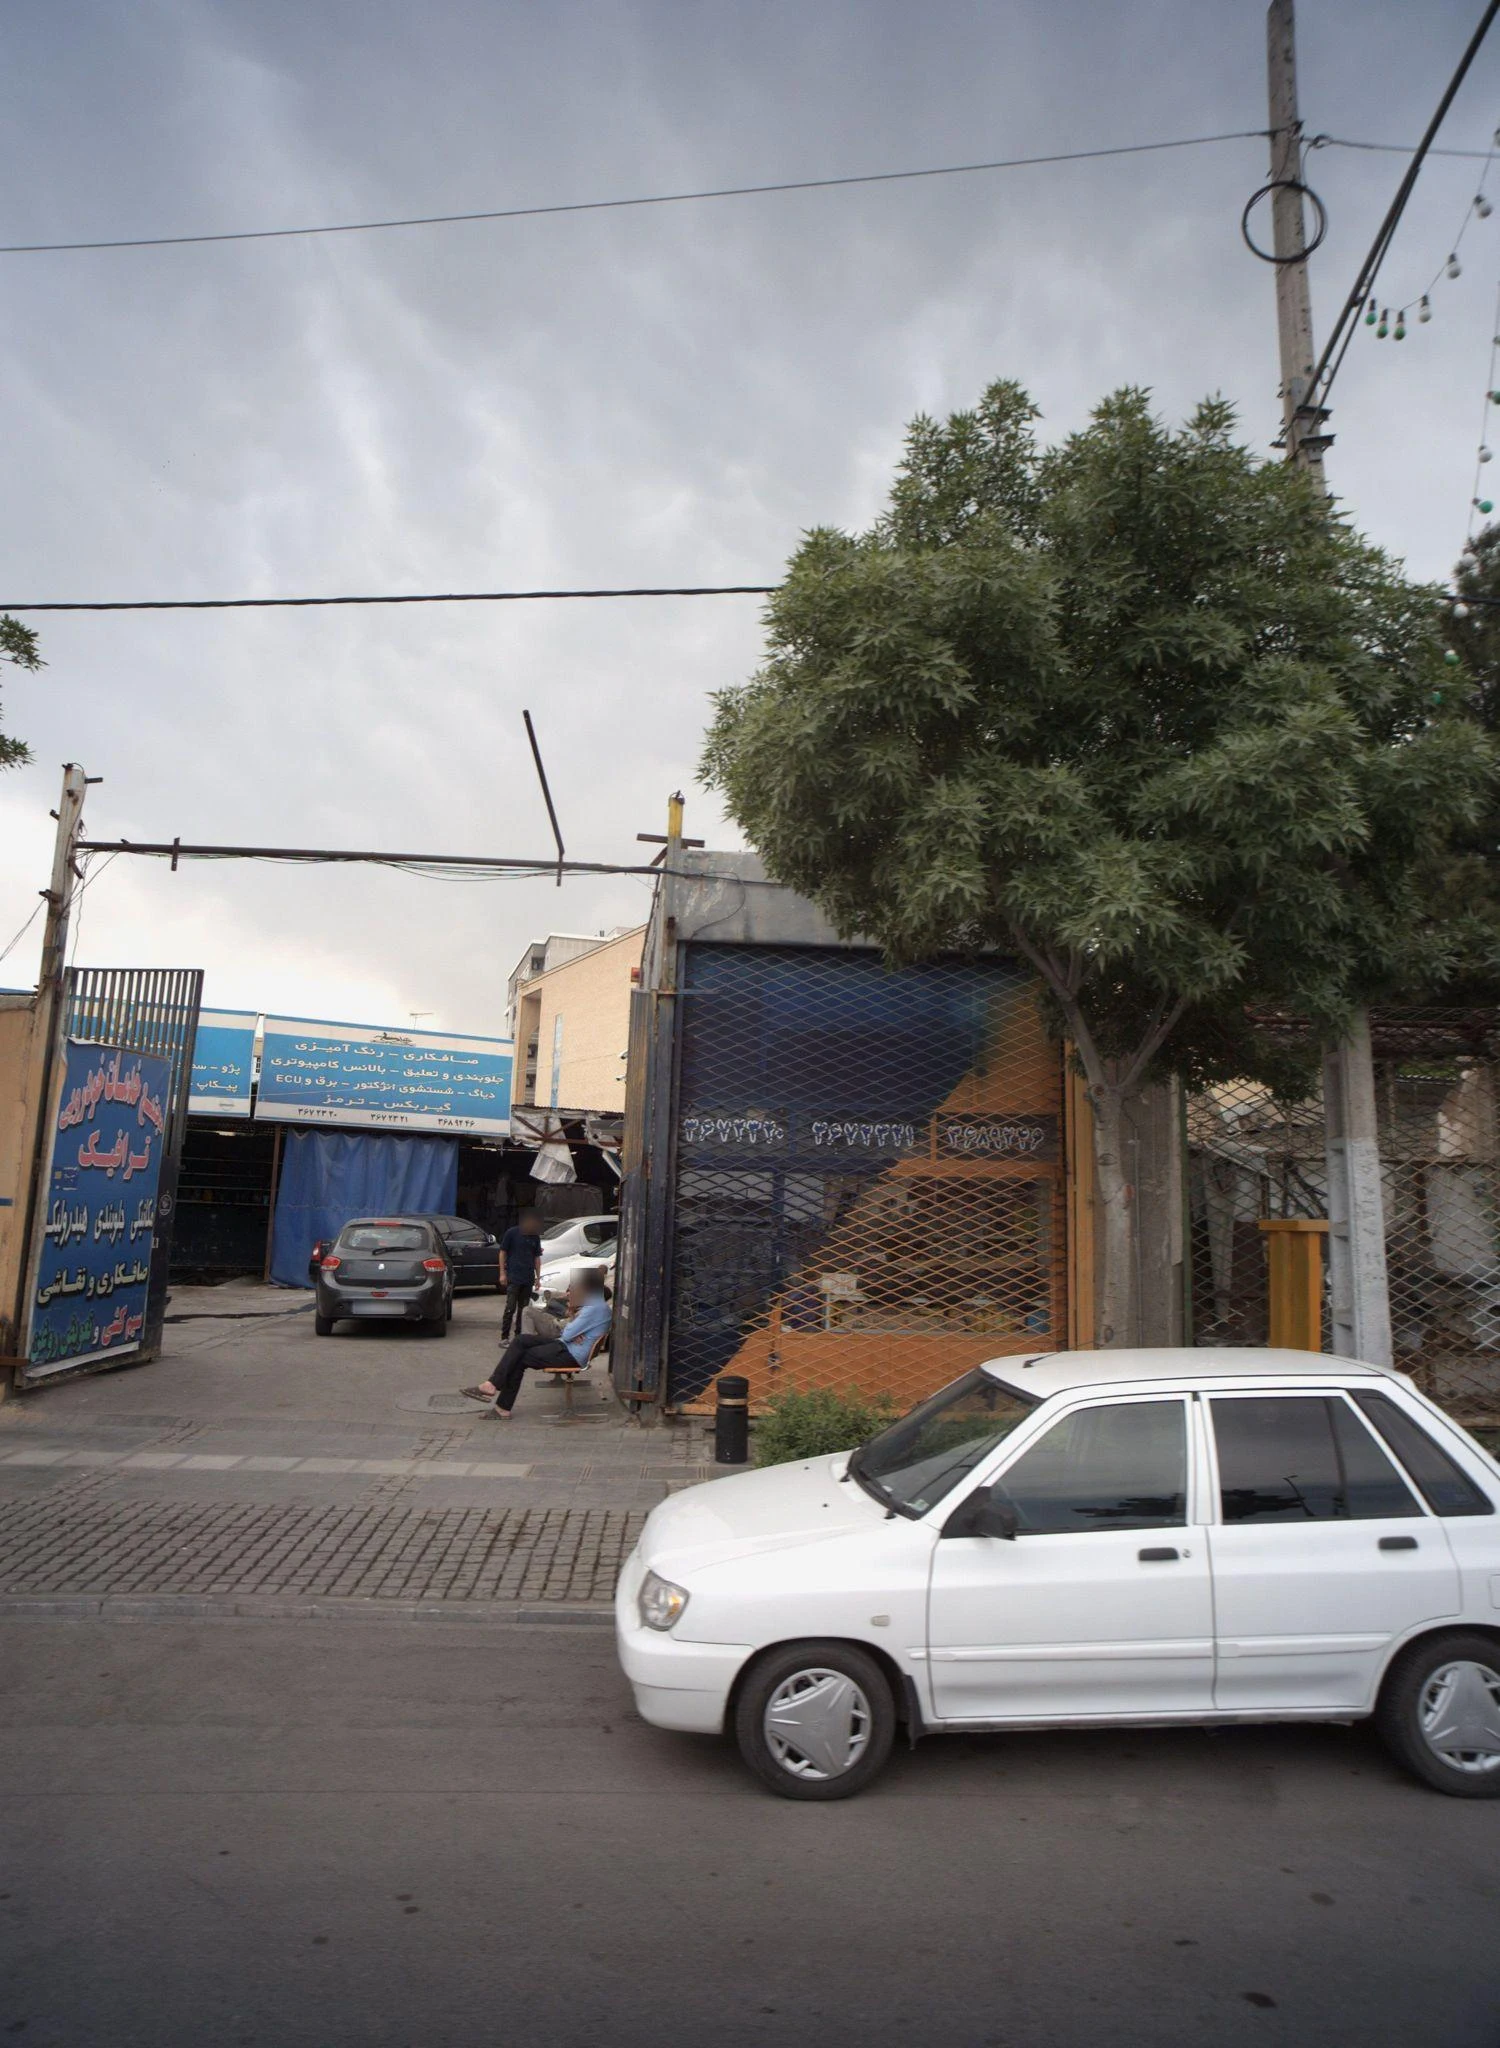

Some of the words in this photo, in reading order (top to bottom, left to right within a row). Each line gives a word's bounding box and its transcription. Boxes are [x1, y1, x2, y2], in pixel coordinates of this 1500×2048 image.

[275, 1074, 302, 1084] ECU
[78, 1128, 151, 1180] ترافیک
[37, 1267, 87, 1304] نقاشی
[97, 1261, 149, 1295] صافکاری
